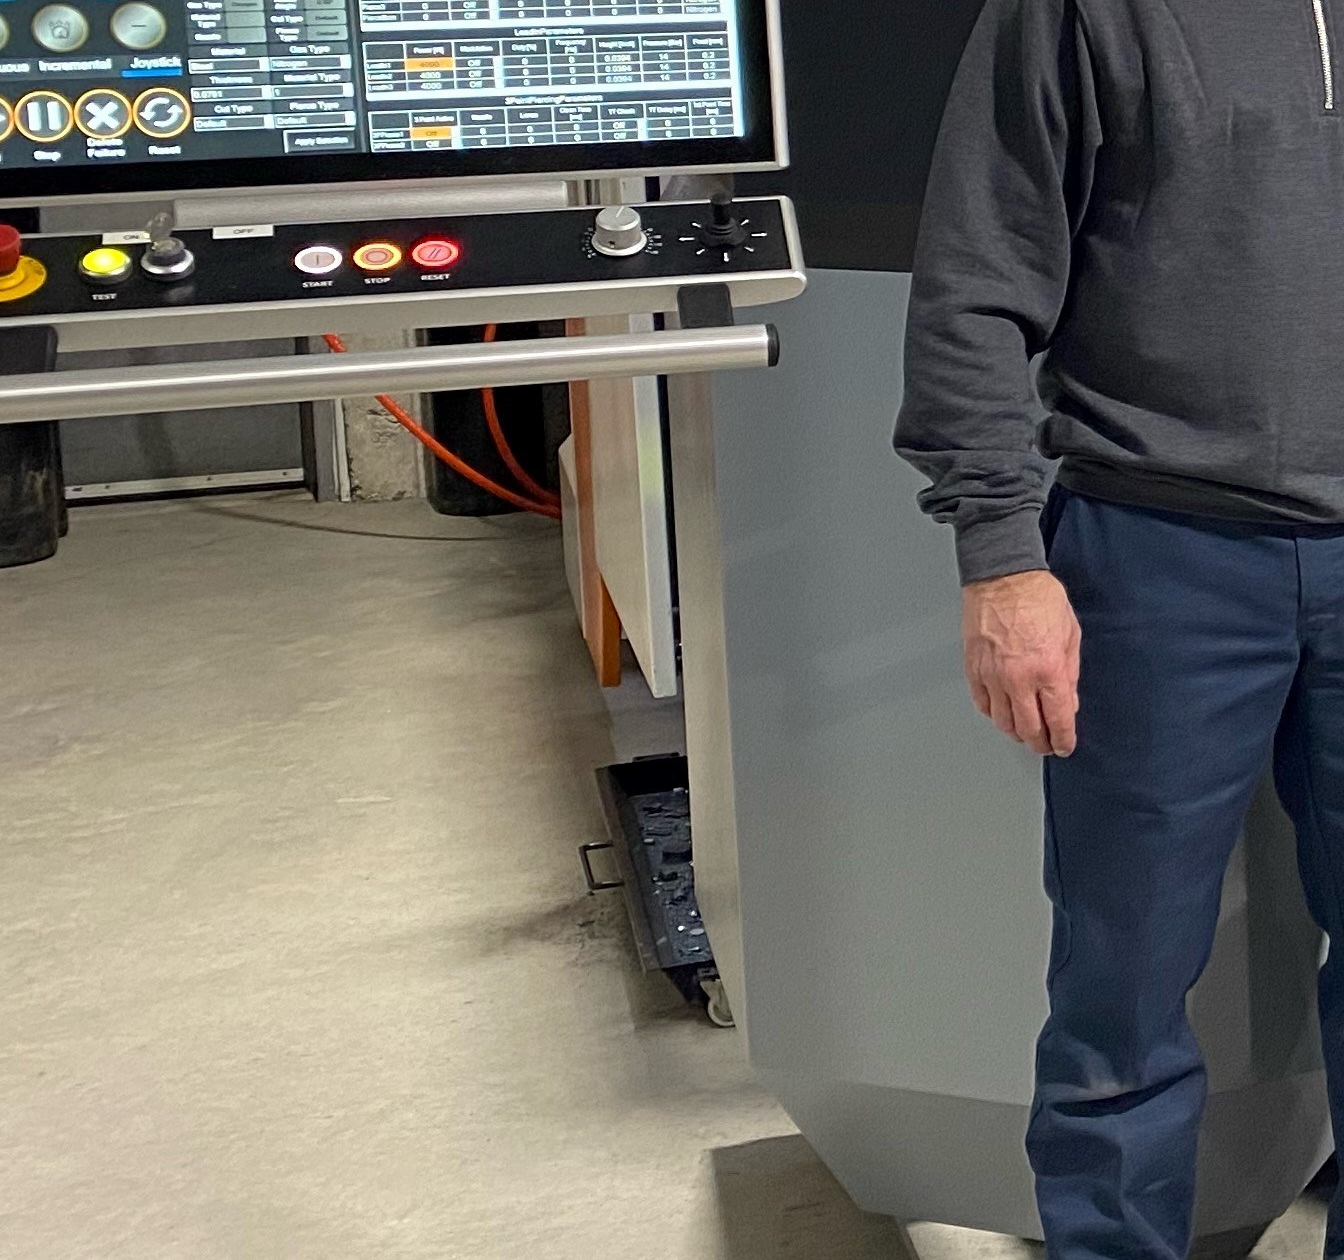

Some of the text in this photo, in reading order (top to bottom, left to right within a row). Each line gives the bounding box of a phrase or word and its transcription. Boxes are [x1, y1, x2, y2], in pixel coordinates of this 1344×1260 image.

[38, 58, 112, 72] Incremental
[130, 56, 182, 70] Joystick
[302, 280, 333, 288] START
[92, 293, 118, 301] TEST
